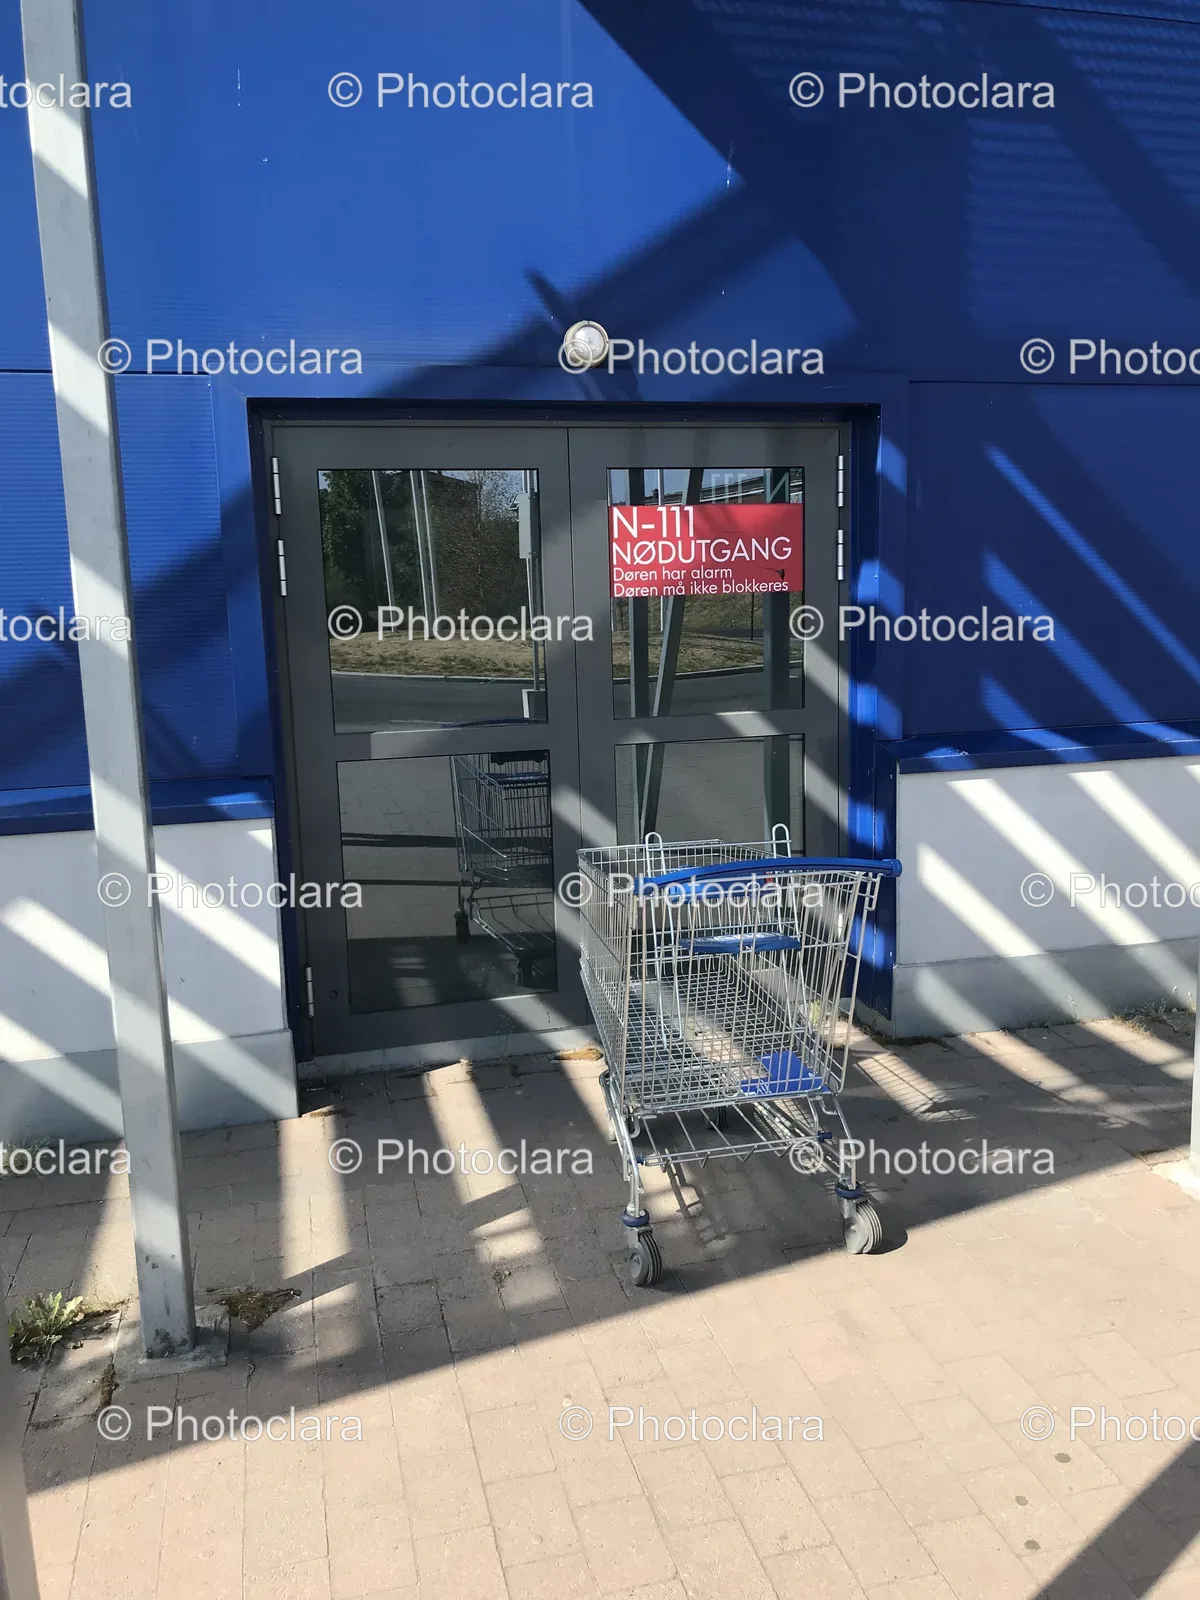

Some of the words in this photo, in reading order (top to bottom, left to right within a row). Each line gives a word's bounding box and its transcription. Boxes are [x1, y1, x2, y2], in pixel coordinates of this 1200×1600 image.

[612, 506, 694, 539] N-111
[612, 536, 792, 566] NØDUTGANG
[613, 567, 657, 582] Døren
[662, 566, 686, 580] har
[691, 565, 732, 579] alarm
[614, 583, 658, 598] Døren
[663, 581, 685, 595] må
[690, 581, 718, 595] ikke
[722, 578, 789, 593] blokkeres
